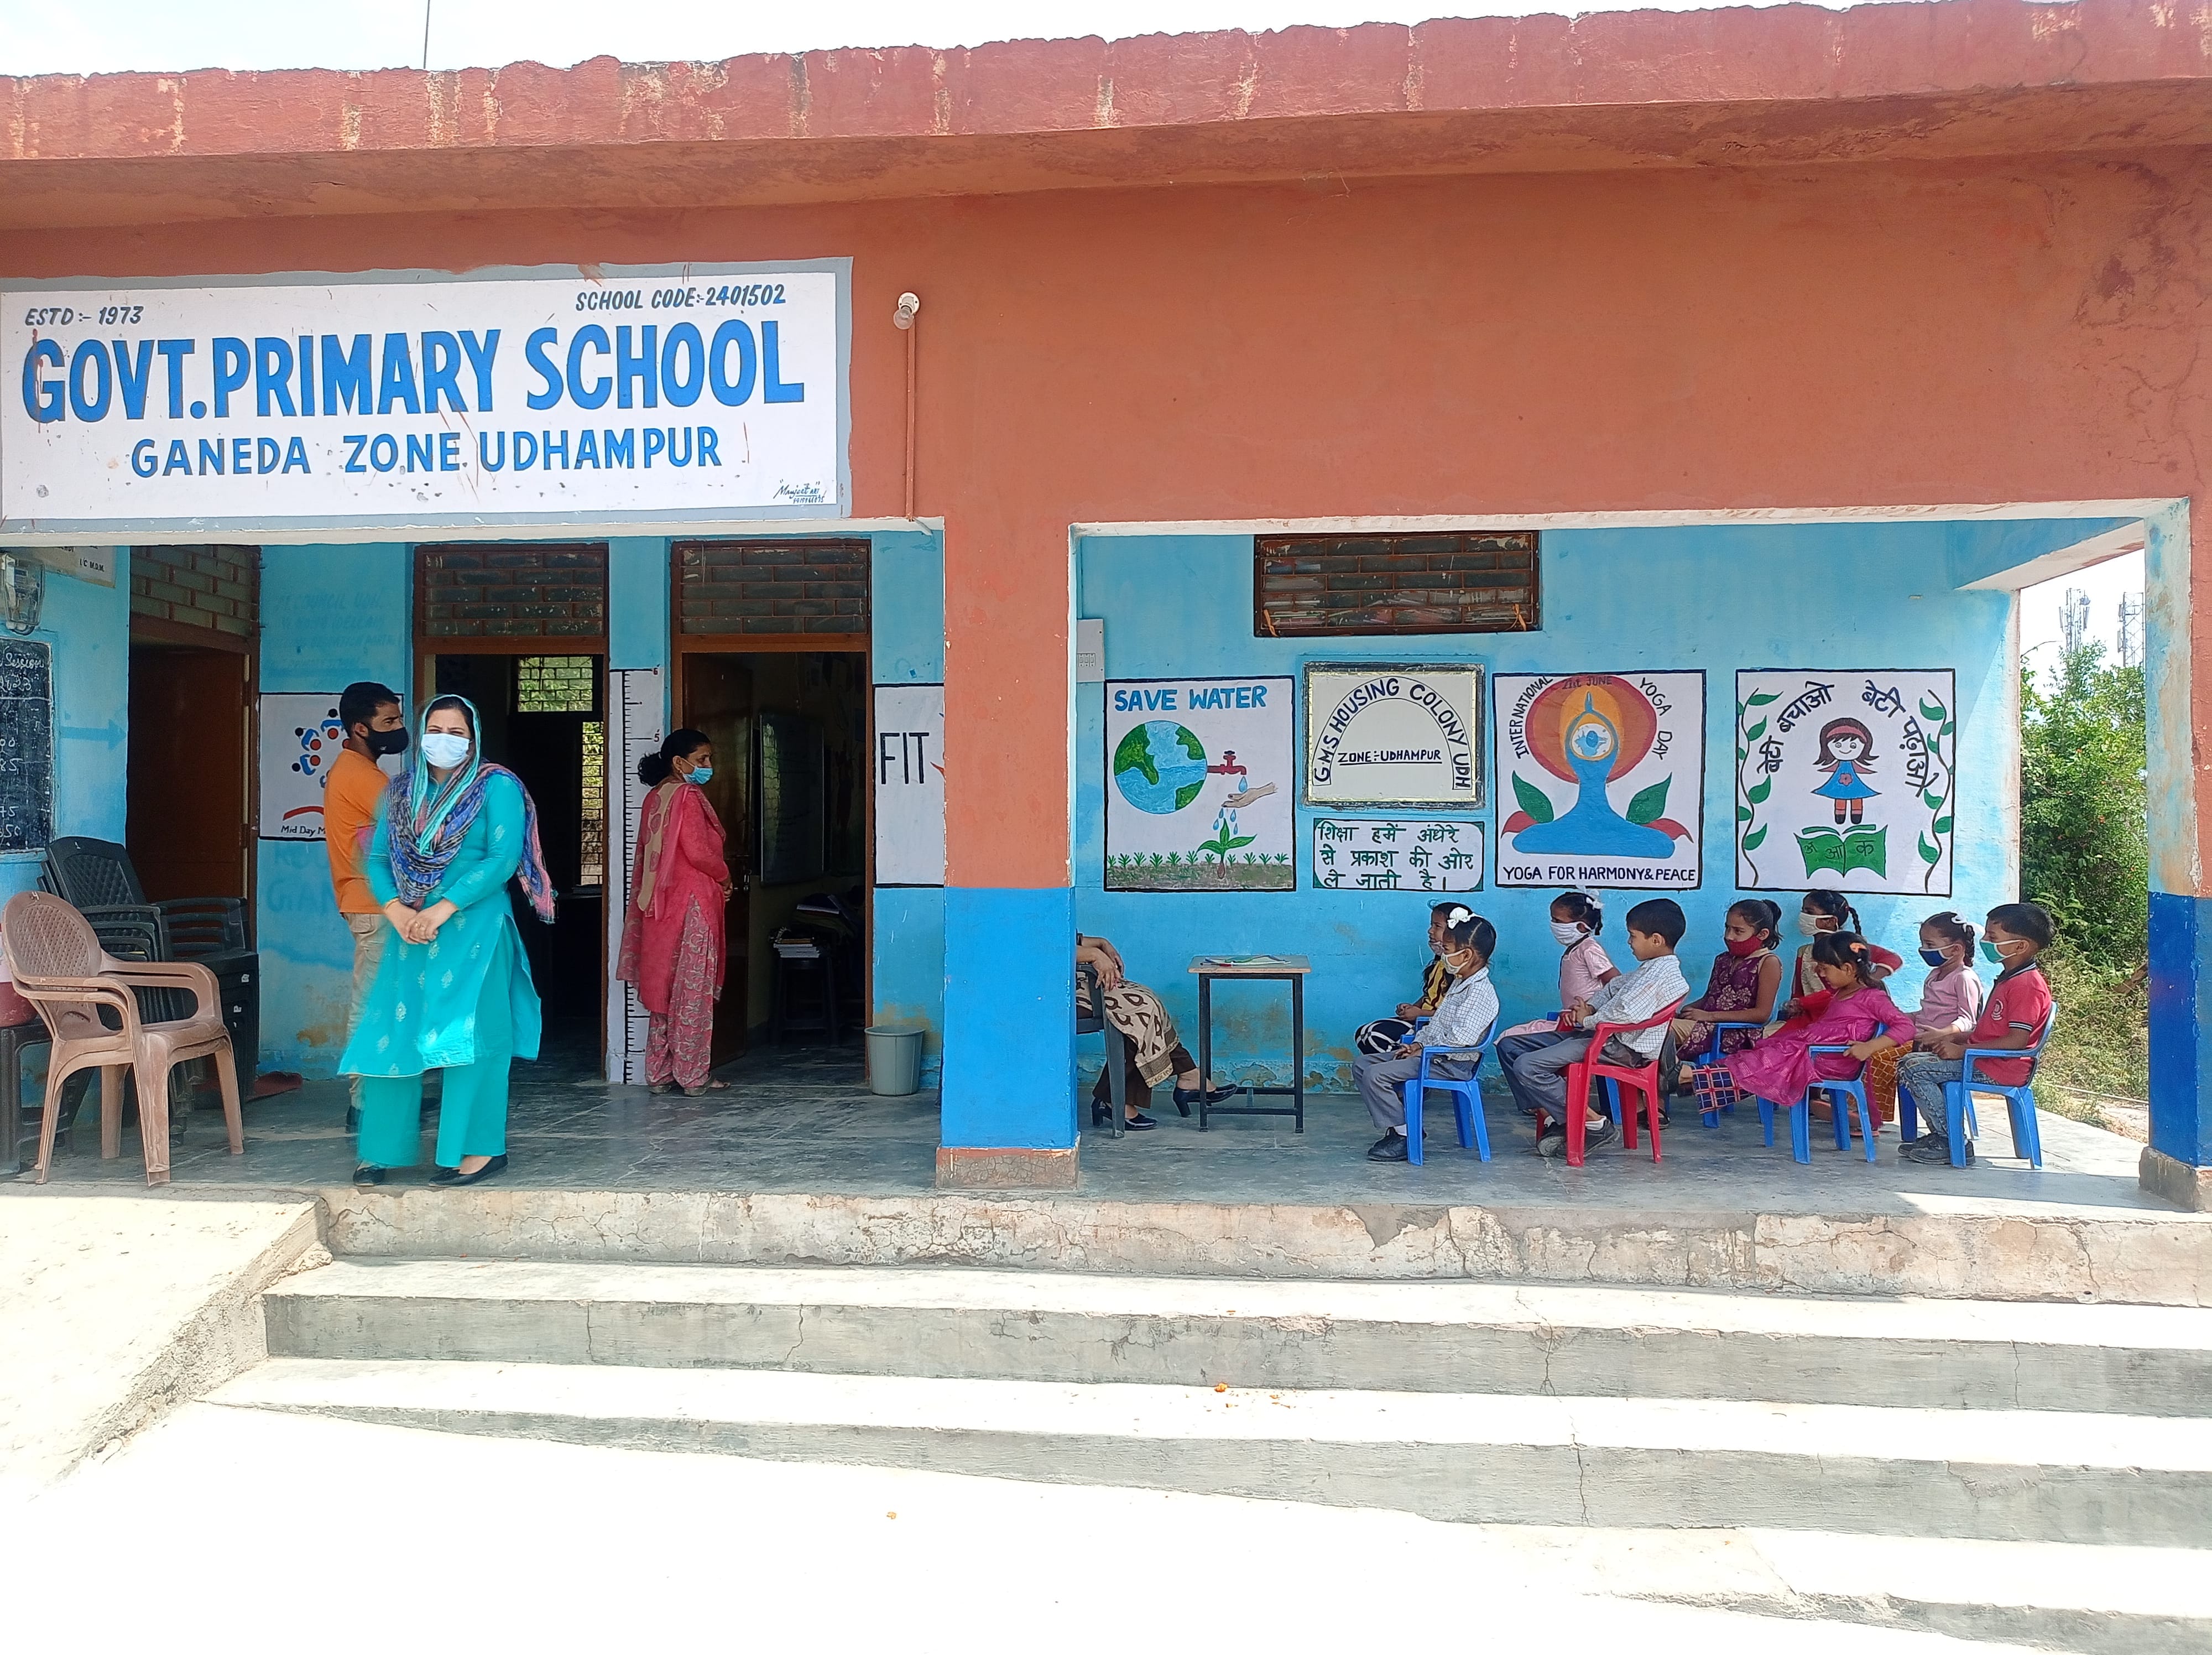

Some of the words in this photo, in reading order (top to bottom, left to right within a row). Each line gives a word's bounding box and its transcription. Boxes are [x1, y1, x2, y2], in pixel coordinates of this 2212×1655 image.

[576, 290, 643, 311] SCHOOL
[99, 306, 144, 325] 1973
[525, 319, 805, 410] SCHOOL
[132, 436, 311, 478] GANEDA
[343, 431, 462, 473] ZONE
[479, 426, 722, 472] UDHAMPUR
[1586, 676, 1613, 686] JUNE
[1114, 689, 1177, 711] SAVE
[1190, 685, 1267, 710] WATER
[1639, 677, 1672, 716] YOGA
[1509, 676, 1553, 759] INTERNATIONAL
[1756, 735, 1783, 774] बेटी
[1777, 680, 1835, 733] बचाओ
[1861, 679, 1906, 718] बेटी
[1329, 678, 1399, 733] HOUSING
[1410, 684, 1468, 746] COLONY
[1453, 753, 1470, 788] UDH
[1652, 730, 1673, 761] DAY
[880, 732, 930, 785] FIT
[281, 825, 297, 834] Mid
[300, 827, 316, 837] Day
[1318, 821, 1359, 843] शिक्षा
[1372, 823, 1406, 844] हमें
[1417, 824, 1459, 843] अंधेरे
[1319, 844, 1336, 865] से
[1350, 851, 1399, 867] प्रकाश
[1409, 846, 1432, 867] की
[1438, 847, 1473, 870] ओर
[1854, 840, 1875, 856] क
[1324, 870, 1345, 887] ले
[1356, 870, 1401, 889] जाती
[1503, 866, 1542, 880] YOGA
[1548, 866, 1575, 879] FOR
